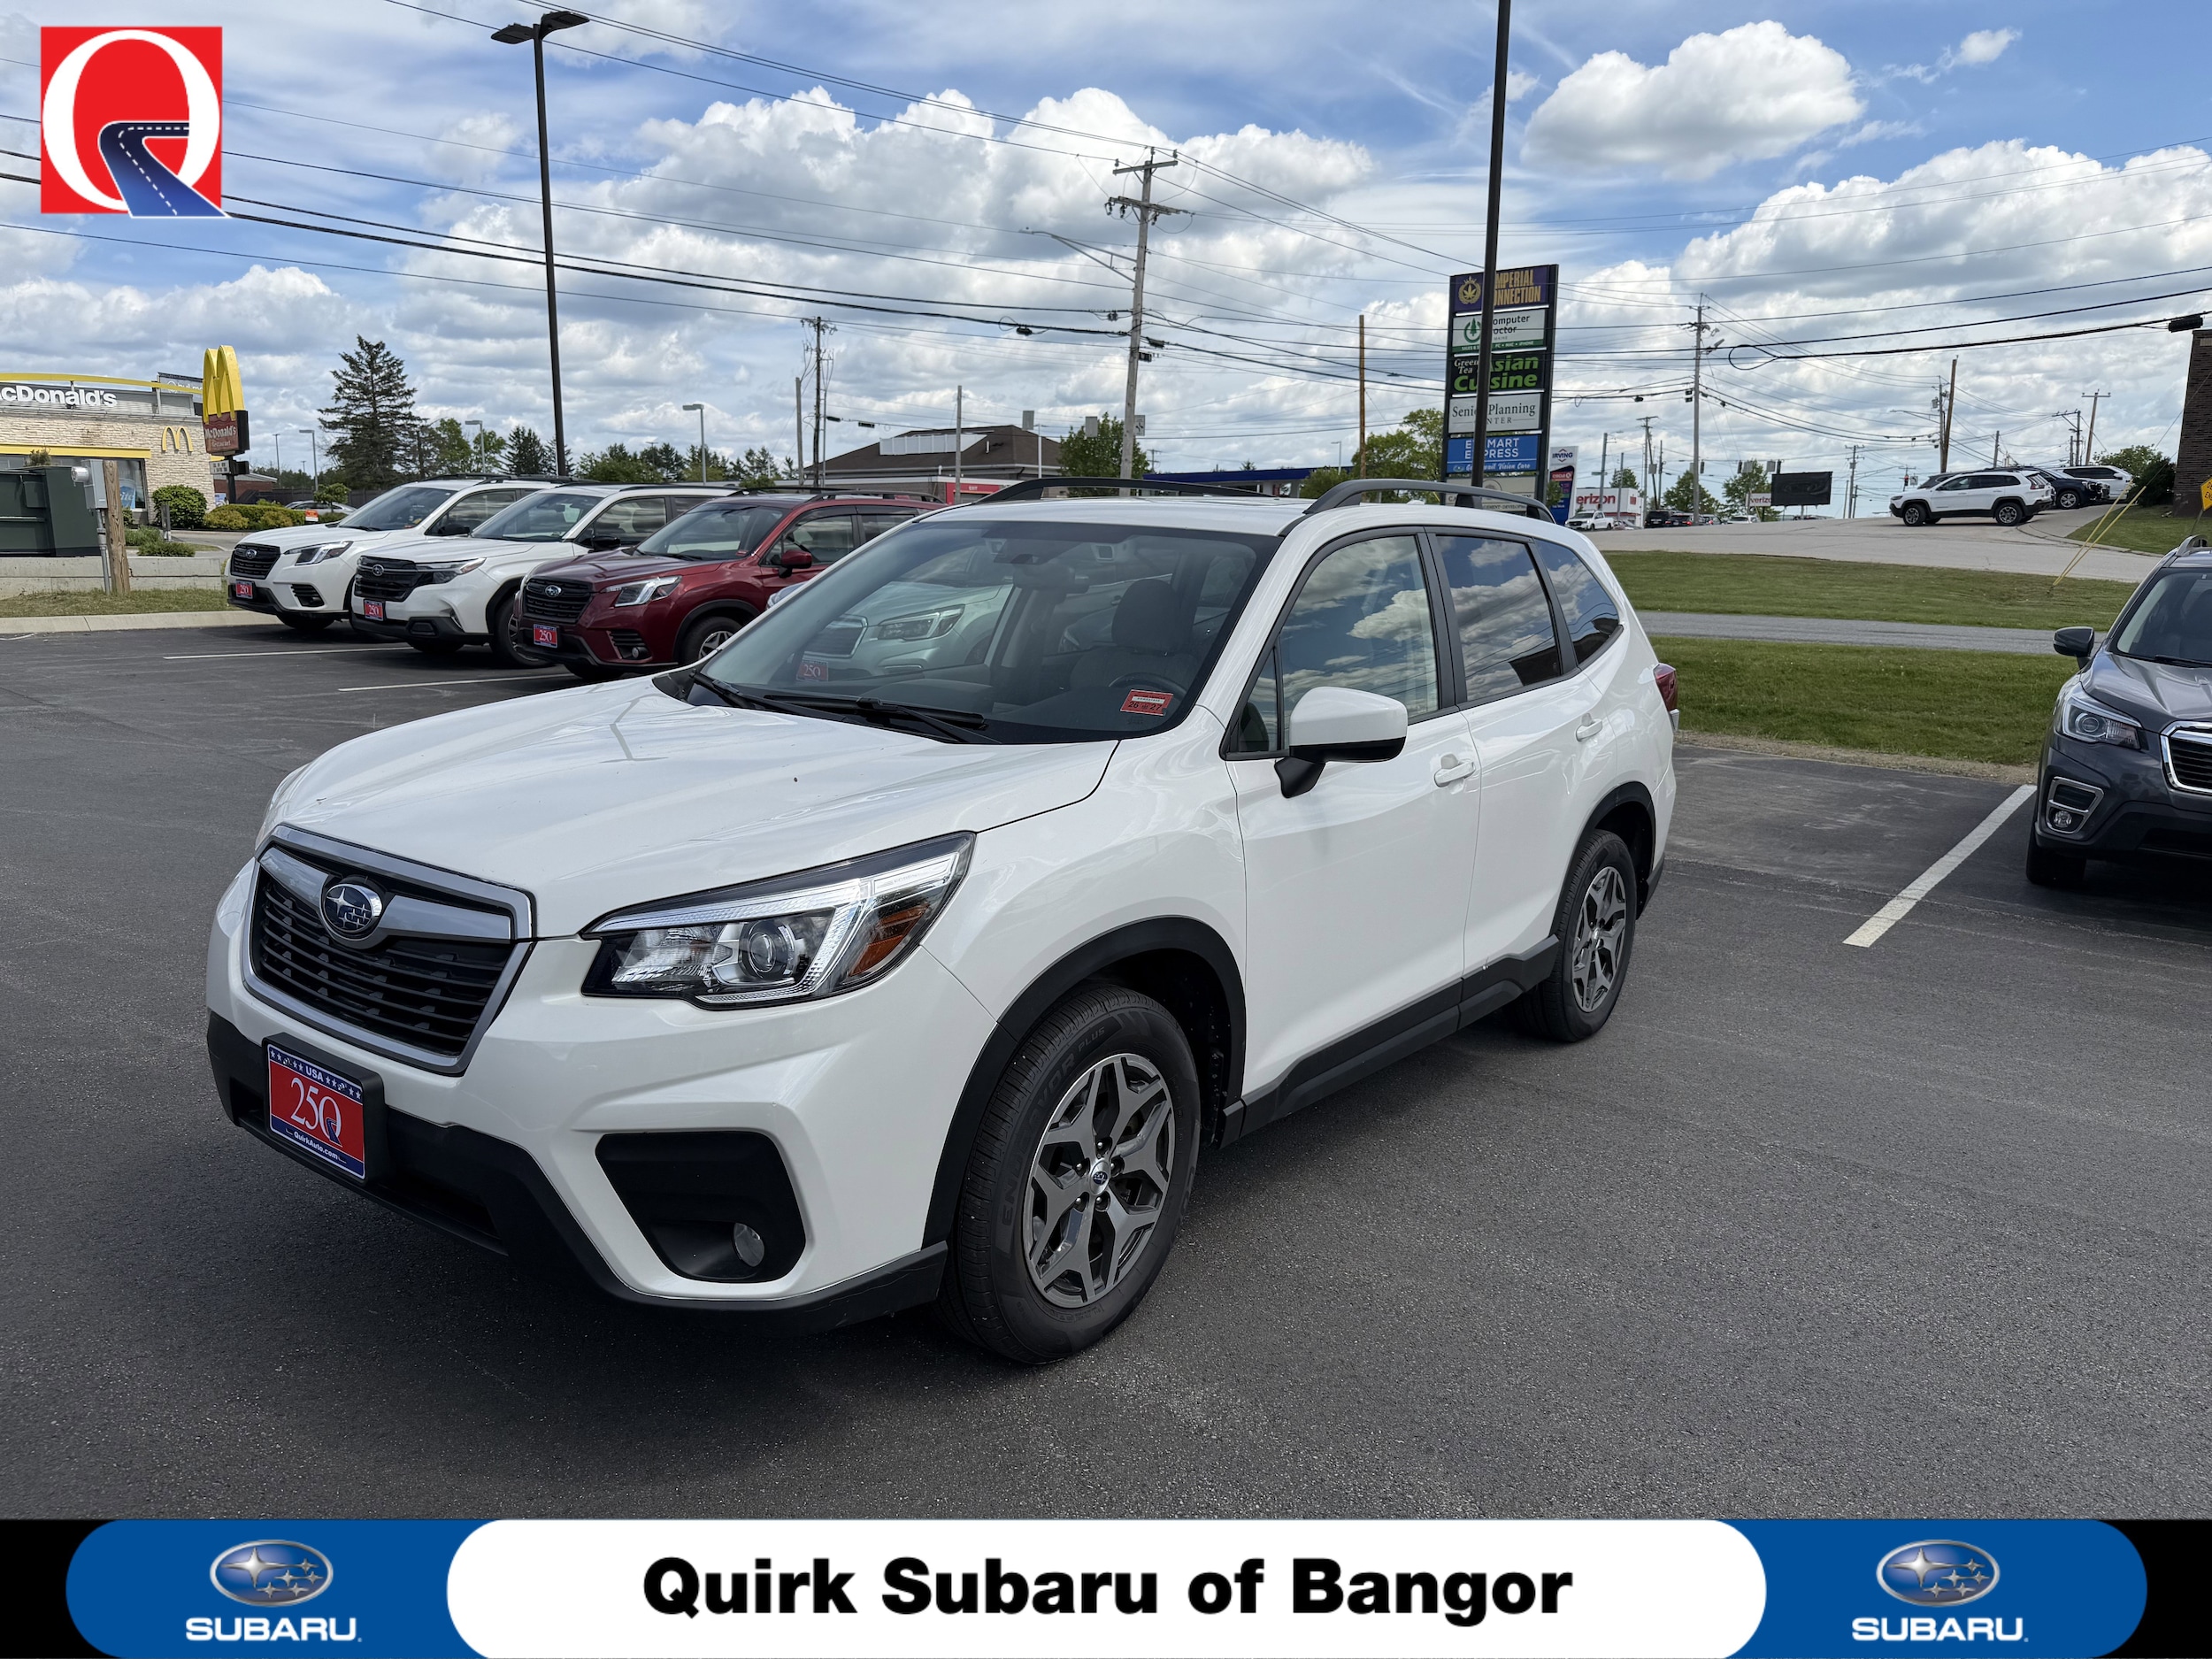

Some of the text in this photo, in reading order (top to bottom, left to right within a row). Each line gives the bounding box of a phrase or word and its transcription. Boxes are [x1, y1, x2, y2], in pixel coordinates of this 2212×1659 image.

[1494, 270, 1533, 289] MPERIAL
[1494, 286, 1541, 306] ONNECTION
[1493, 315, 1530, 326] omputer
[1493, 326, 1517, 334] octor
[1454, 373, 1538, 391] Cusine
[0, 385, 118, 407] cDonald's
[1452, 403, 1536, 418] Seni Planning
[1465, 438, 1519, 449] EMART
[1464, 448, 1519, 460] EPRESS
[305, 1066, 324, 1083] USA
[294, 1131, 338, 1161] QuirkAuto.com
